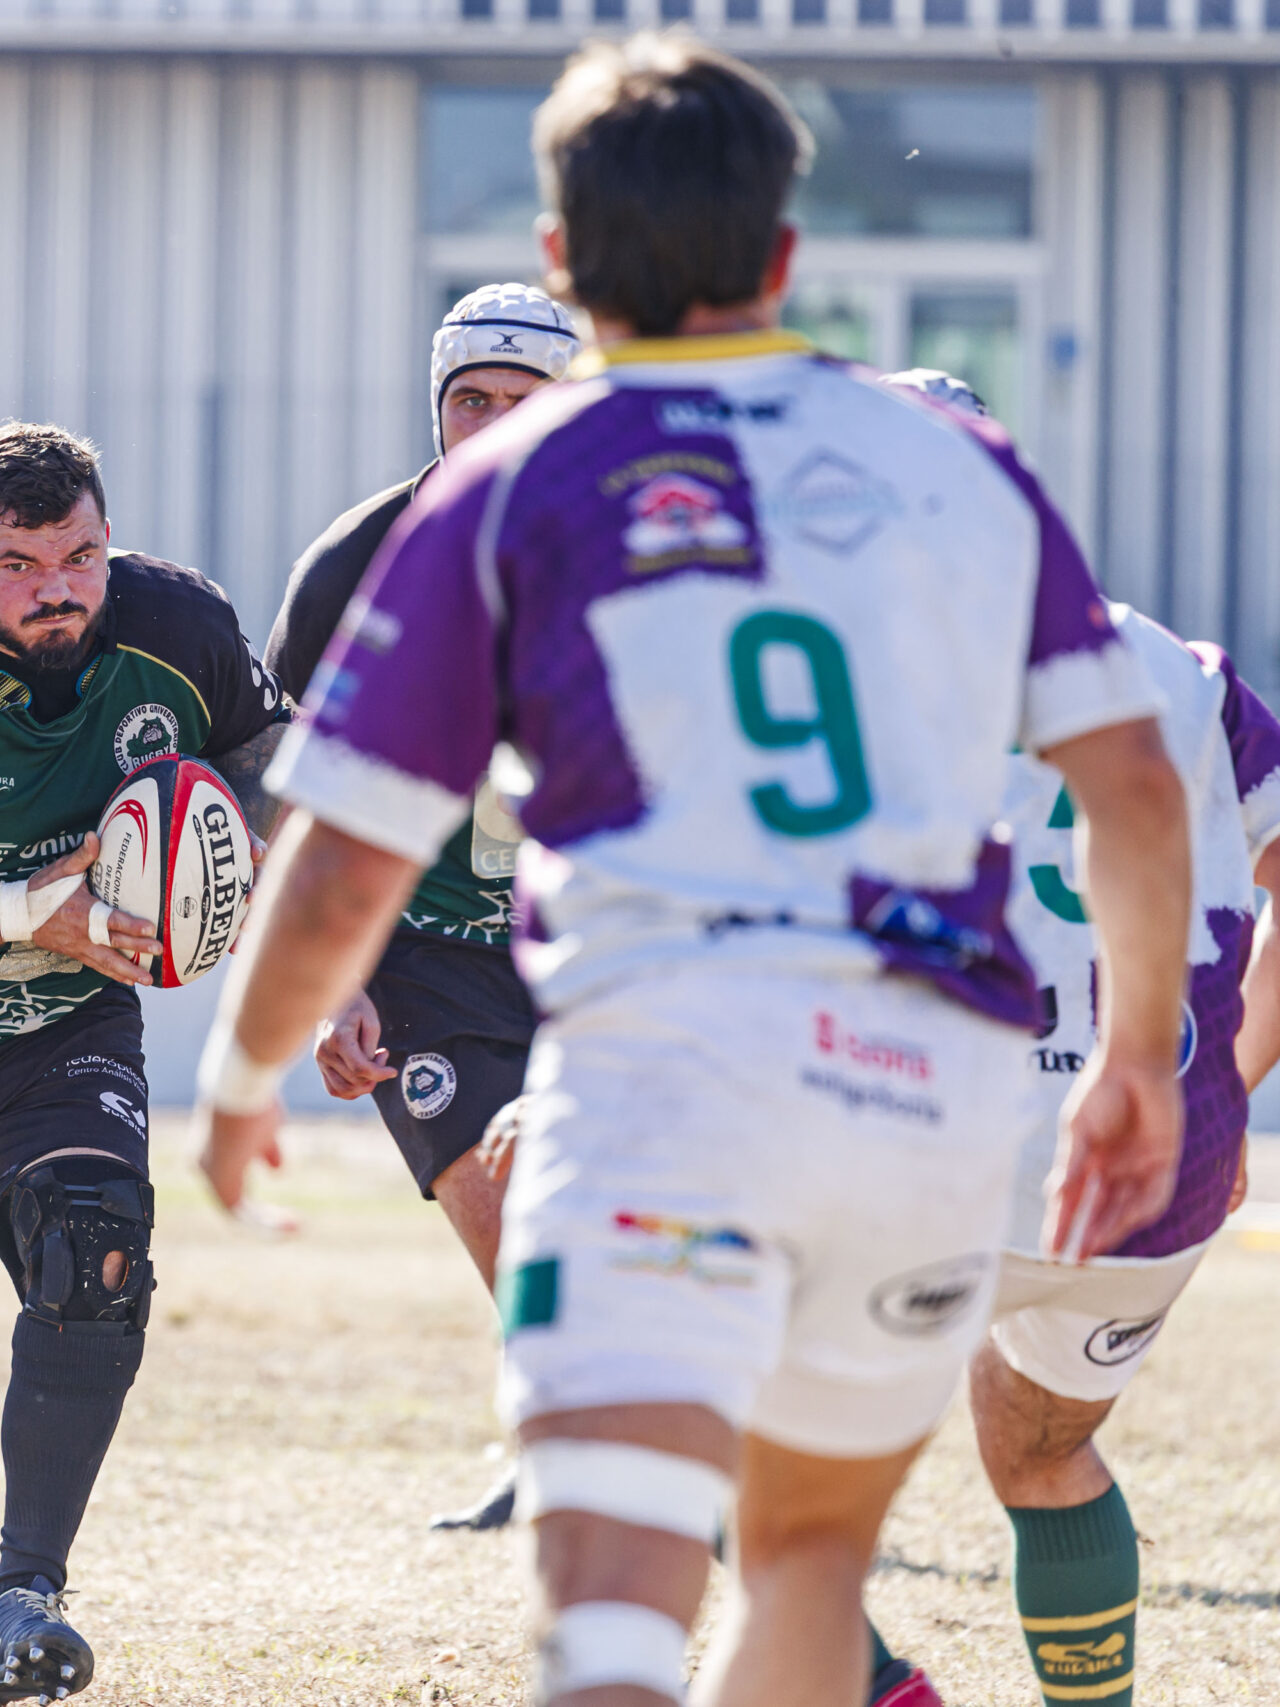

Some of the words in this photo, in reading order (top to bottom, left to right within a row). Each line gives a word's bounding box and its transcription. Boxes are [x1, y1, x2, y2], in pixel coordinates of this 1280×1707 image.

[115, 705, 147, 744] DEPORTIVO
[149, 704, 178, 748] UNIVERSITARIO
[729, 610, 874, 837] 9
[115, 747, 129, 771] CLUB
[131, 745, 170, 769] RUGBY
[105, 864, 113, 879] DE
[113, 831, 133, 895] FEDERACION
[194, 803, 235, 974] GILBERT
[67, 1067, 100, 1078] Centro
[101, 1066, 133, 1084] Análisis
